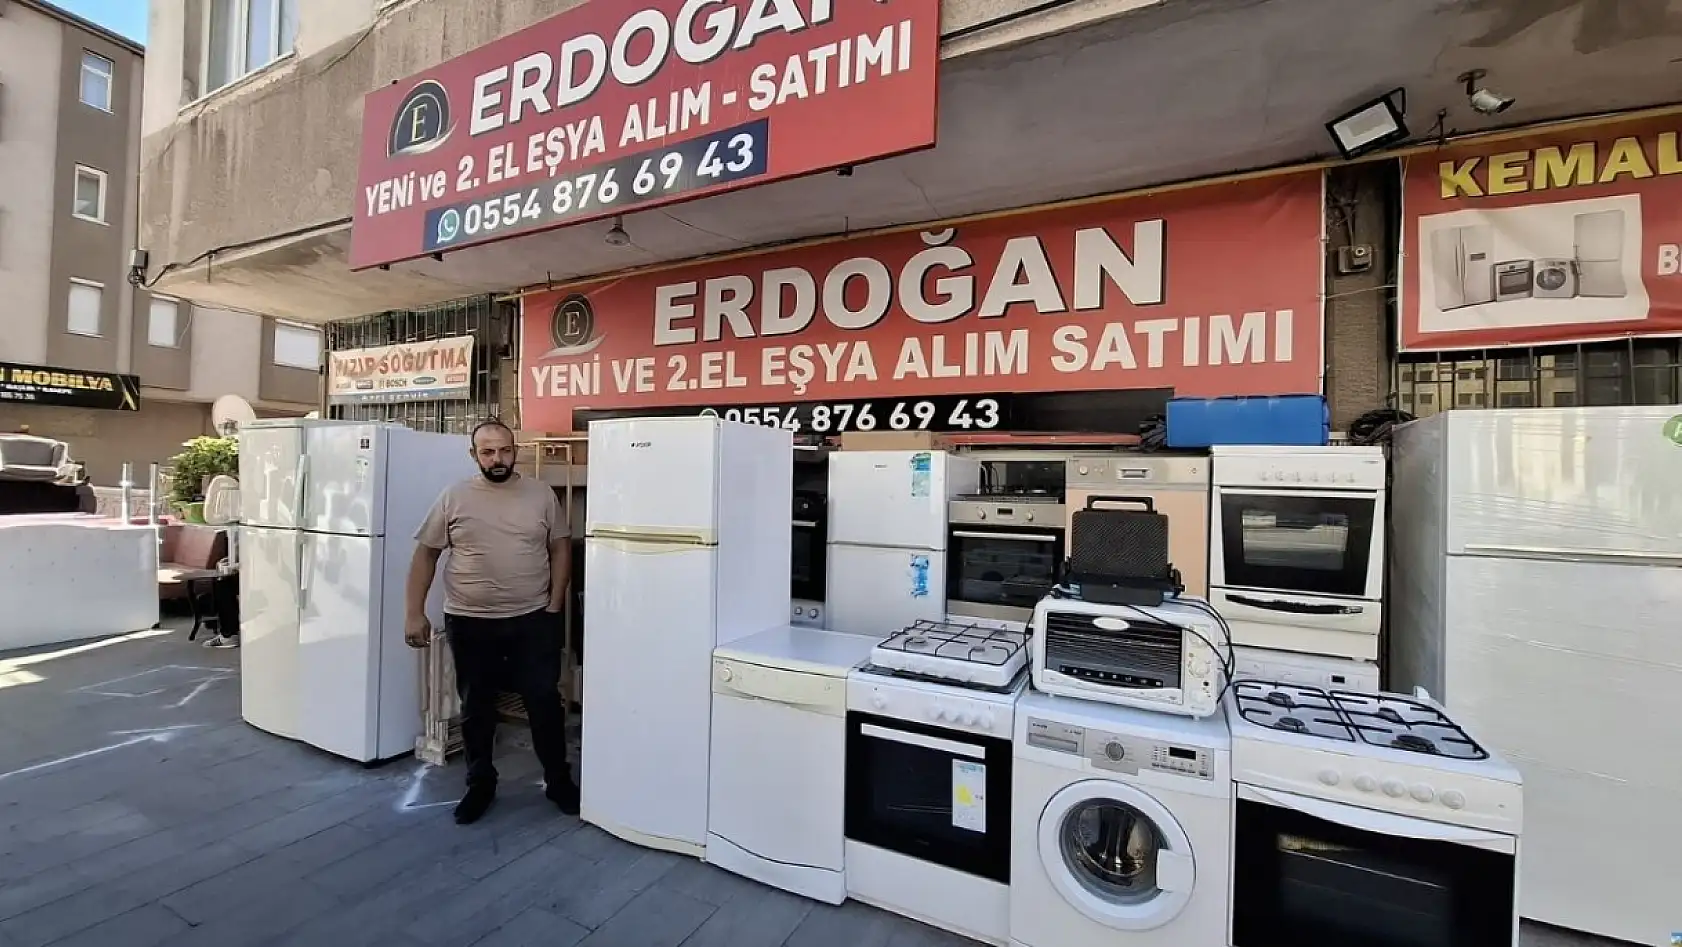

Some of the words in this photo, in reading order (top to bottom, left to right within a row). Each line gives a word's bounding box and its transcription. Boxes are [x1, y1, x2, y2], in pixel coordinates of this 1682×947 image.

[409, 104, 428, 142] E
[419, 170, 447, 201] ve
[456, 155, 480, 192] 2.
[487, 142, 520, 184] EL
[526, 116, 607, 179] EŞYA
[619, 80, 711, 148] ALIM
[748, 19, 911, 111] SATIMI
[464, 188, 541, 236] 0554
[553, 166, 619, 216] 876
[632, 151, 683, 195] 69
[696, 133, 754, 177] 43
[1439, 131, 1682, 200] KEMAL
[653, 219, 1165, 347] ERDOĞAN
[531, 353, 600, 397] YENİ
[612, 357, 655, 393] VE
[667, 351, 747, 391] 2.EL
[761, 340, 878, 395] EŞYA
[892, 328, 1029, 379] ALIM
[1050, 309, 1293, 373] SATIMI
[564, 311, 580, 336] E
[811, 403, 876, 432] 876
[889, 401, 936, 430] 69
[948, 398, 999, 429] 43
